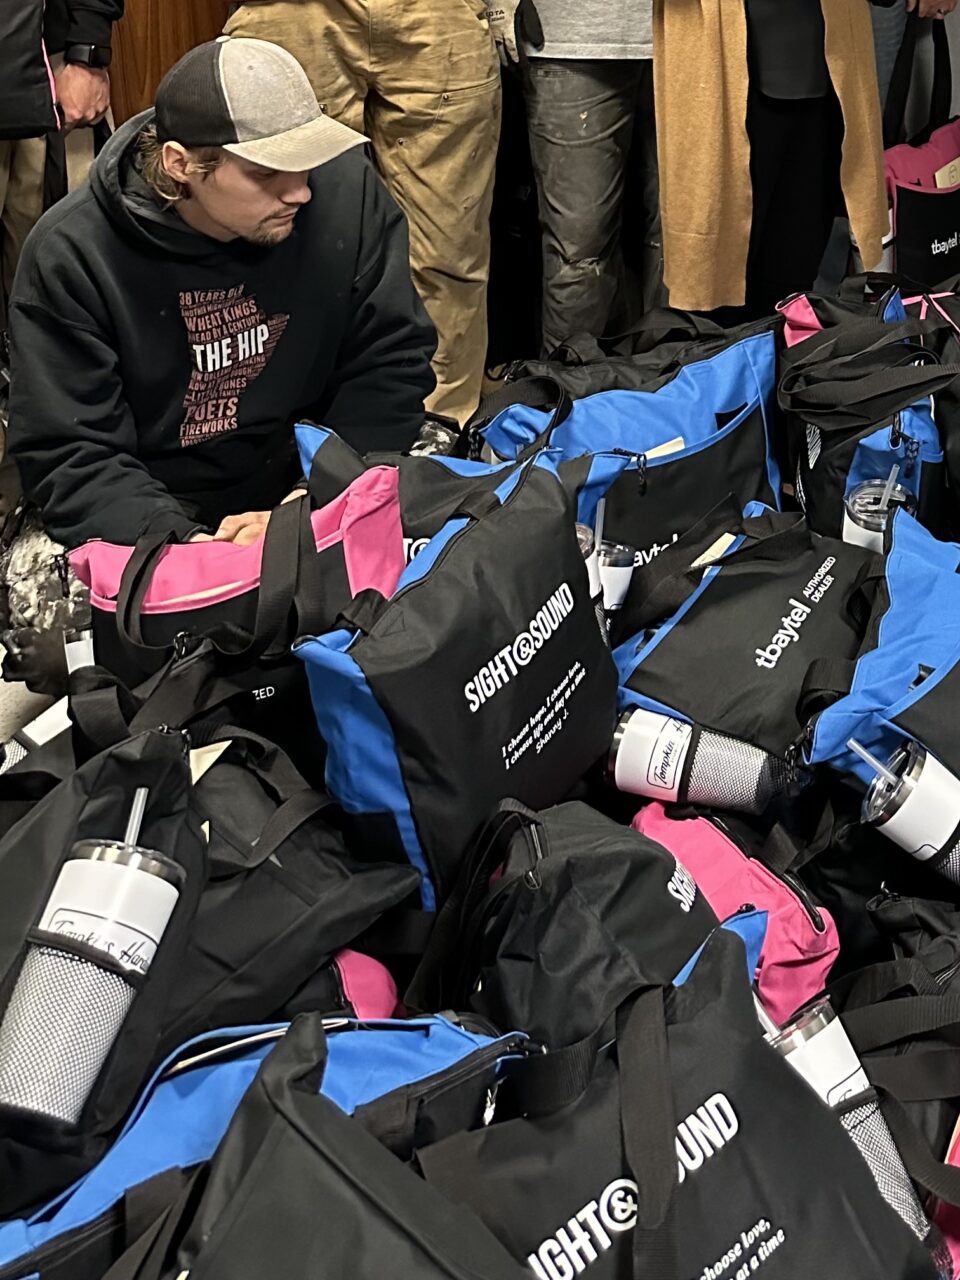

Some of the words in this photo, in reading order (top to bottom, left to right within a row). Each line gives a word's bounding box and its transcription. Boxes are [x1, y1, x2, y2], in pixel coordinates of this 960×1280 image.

[931, 231, 958, 255] tbaytel
[179, 292, 192, 306] 38
[194, 290, 226, 303] YEARS
[185, 311, 222, 332] WHEAT
[223, 300, 257, 323] KINGS
[229, 313, 260, 332] CENTURY
[193, 337, 233, 373] THE
[237, 324, 270, 361] HIP
[184, 397, 239, 423] POETS
[180, 417, 238, 437] FIREWORKS
[802, 556, 836, 599] AUTHORIZED
[810, 574, 835, 603] DEALER
[755, 598, 812, 669] tbaytel
[502, 746, 506, 758] I
[508, 724, 529, 752] choose
[551, 675, 569, 702] choose
[505, 758, 510, 770] I
[511, 736, 532, 764] choose
[533, 723, 543, 739] life
[544, 709, 554, 726] one
[536, 718, 562, 754] Shanny
[741, 1219, 771, 1248] love,
[750, 1255, 759, 1270] a
[758, 1228, 785, 1261] time
